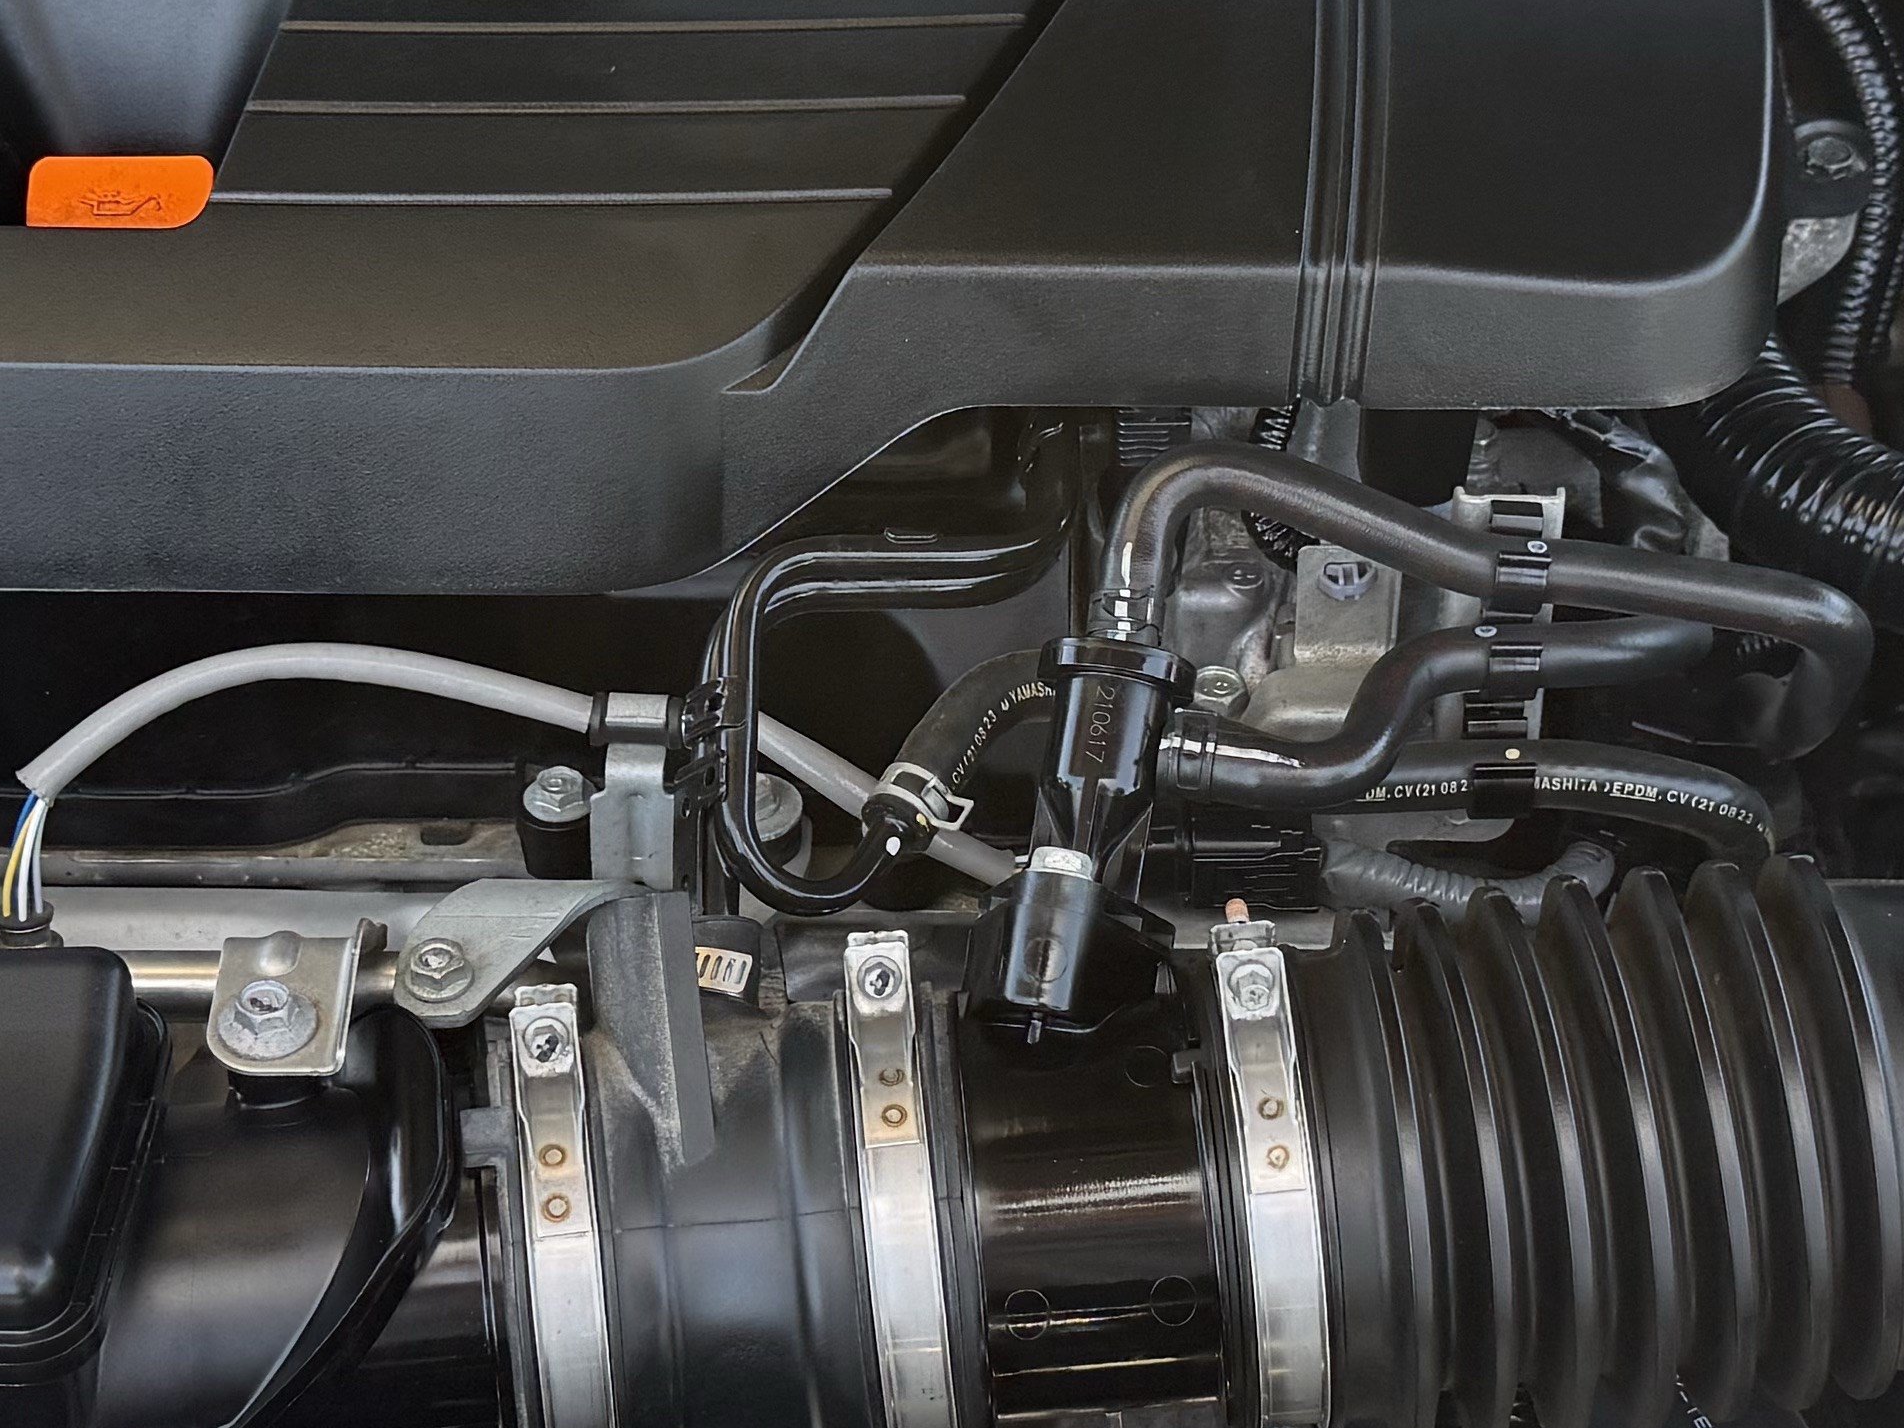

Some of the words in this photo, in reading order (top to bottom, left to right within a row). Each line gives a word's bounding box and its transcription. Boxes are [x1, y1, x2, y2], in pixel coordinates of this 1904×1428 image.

[1084, 684, 1116, 764] 210617
[1441, 781, 1457, 795] 08
[1461, 779, 1474, 792] 2
[1718, 803, 1737, 819] 08
